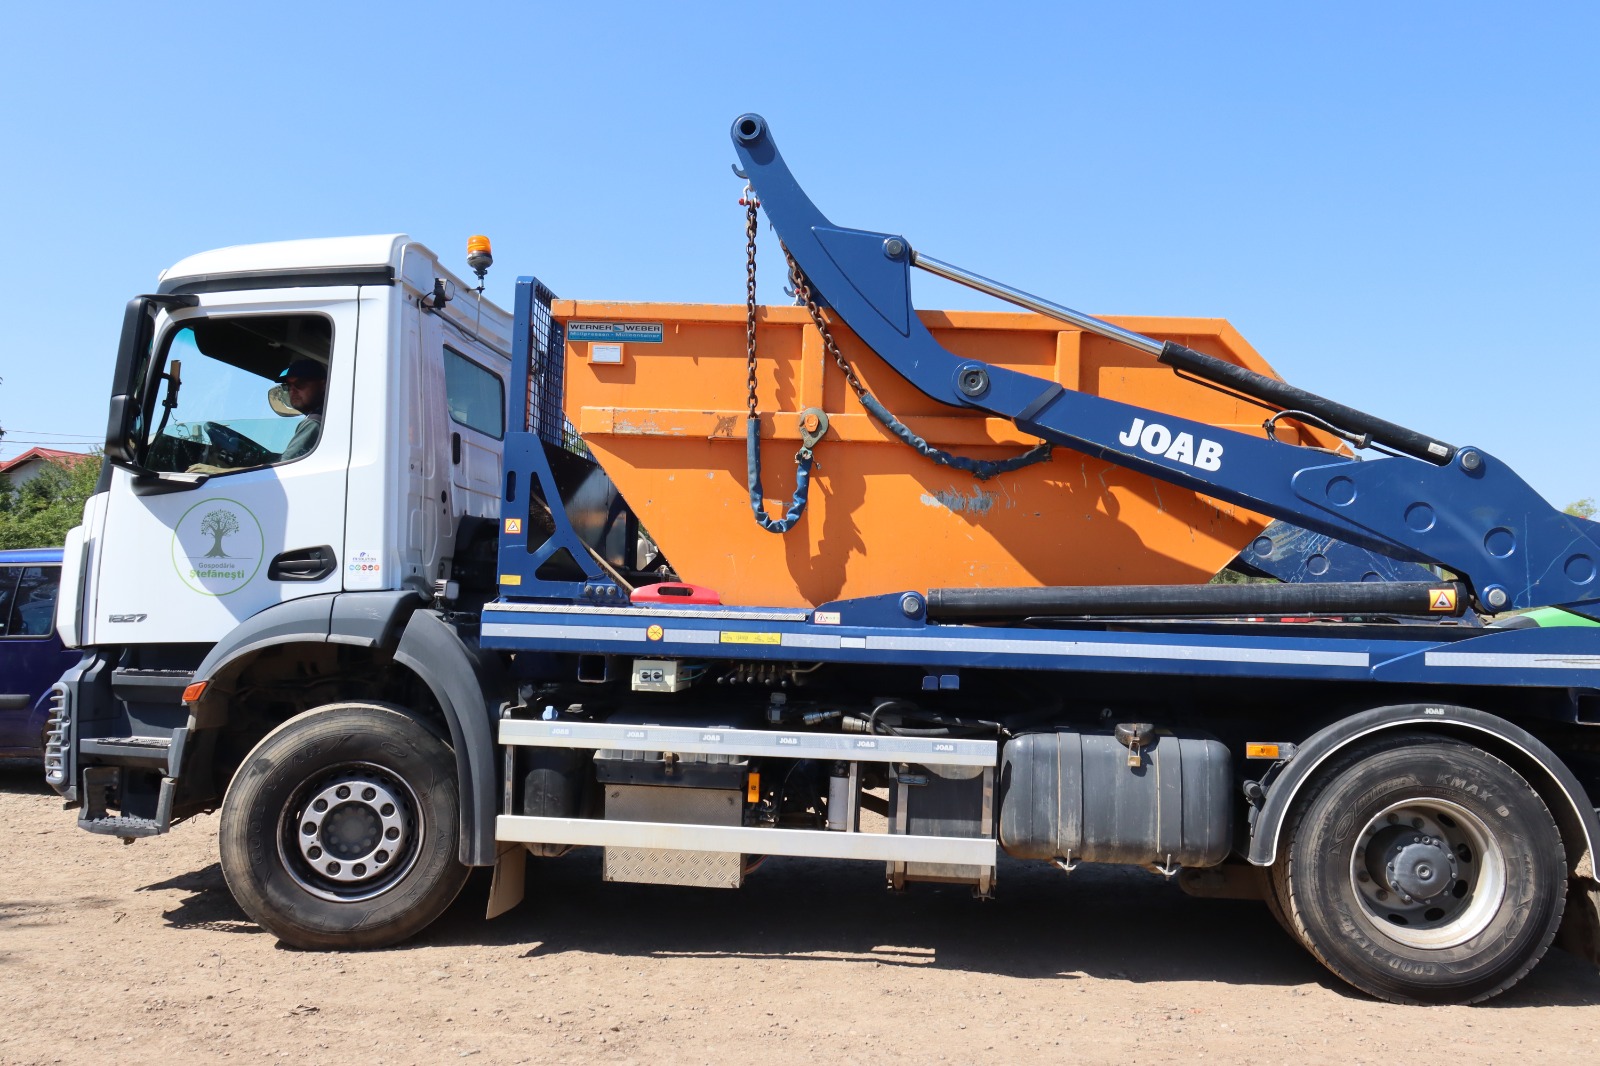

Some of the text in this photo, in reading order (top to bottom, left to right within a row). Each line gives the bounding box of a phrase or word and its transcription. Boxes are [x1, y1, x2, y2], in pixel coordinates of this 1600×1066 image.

[1119, 418, 1224, 472] JOAB
[108, 613, 148, 623] 1827
[1436, 773, 1511, 818] KMAX D
